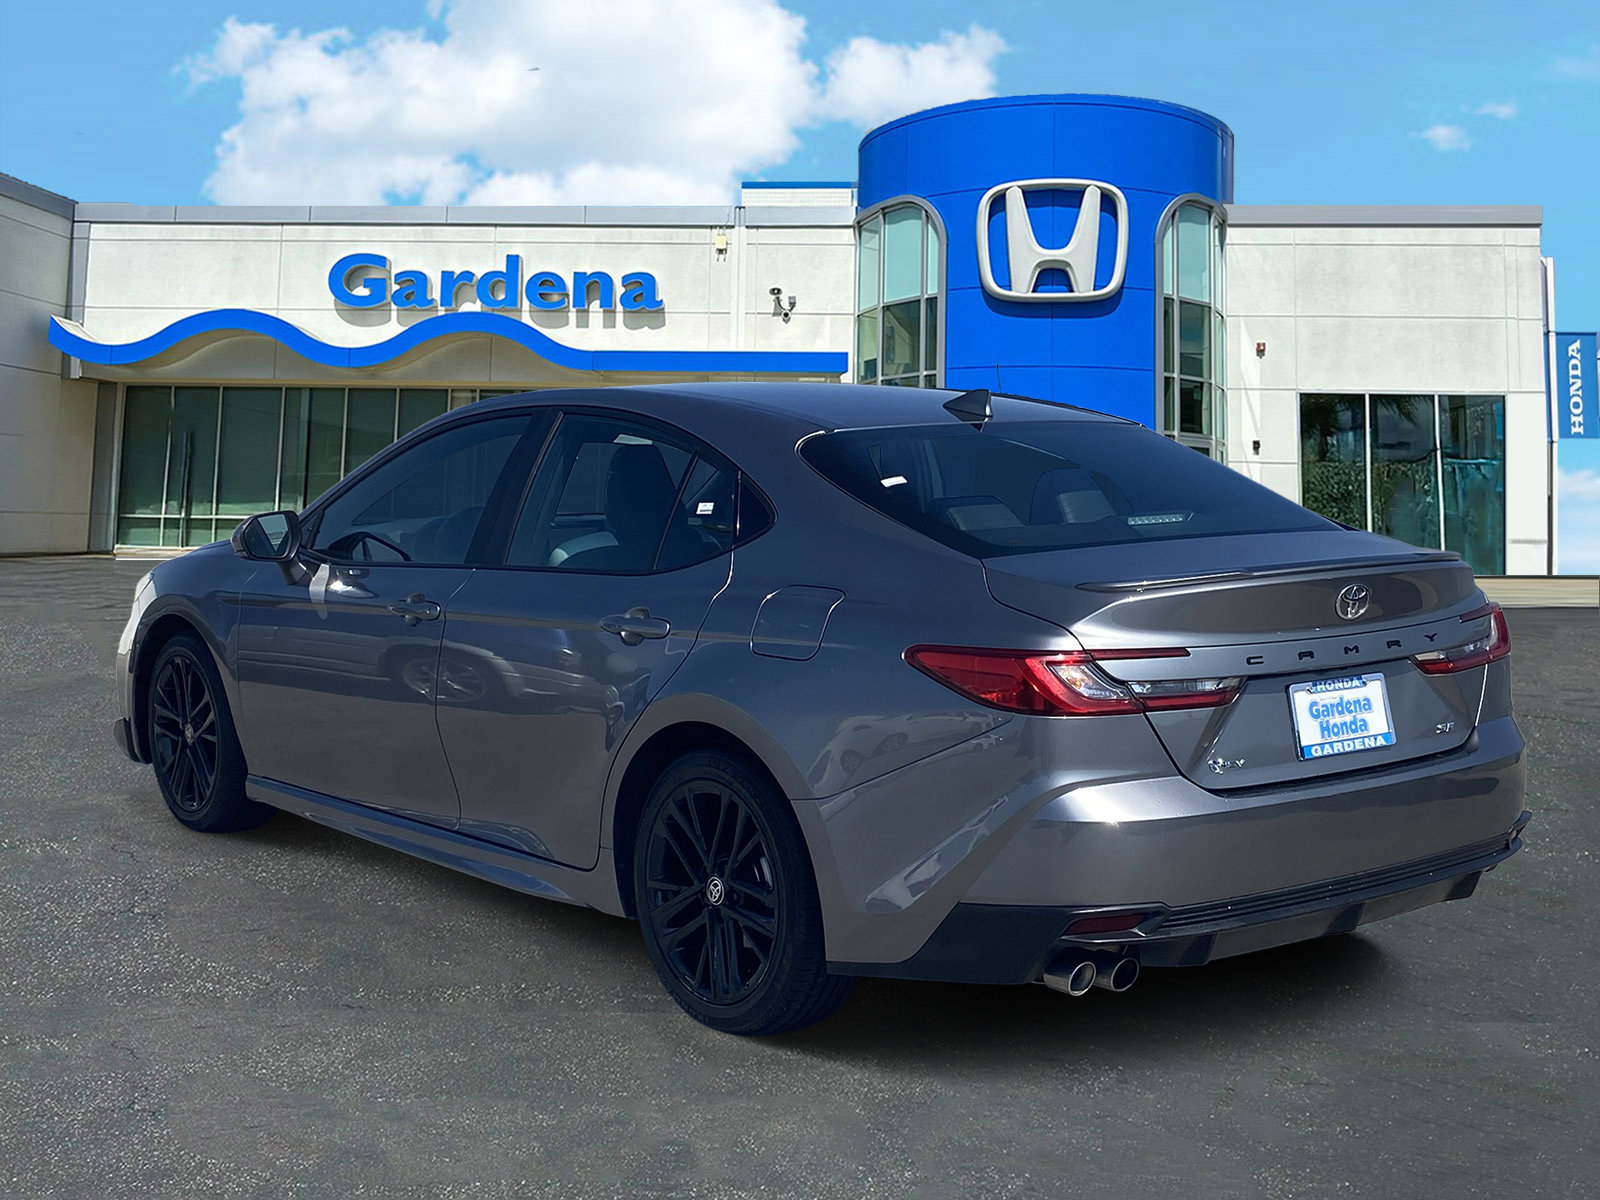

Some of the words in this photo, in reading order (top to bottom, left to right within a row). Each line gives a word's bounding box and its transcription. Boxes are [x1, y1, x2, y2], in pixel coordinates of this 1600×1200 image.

[328, 252, 664, 310] Gardena
[1567, 338, 1584, 435] HONDA
[1246, 632, 1438, 666] CAMRY
[1315, 678, 1361, 693] HONDA
[1308, 696, 1373, 721] Gardena
[1318, 715, 1369, 740] Honda
[1311, 735, 1387, 757] GARDENA
